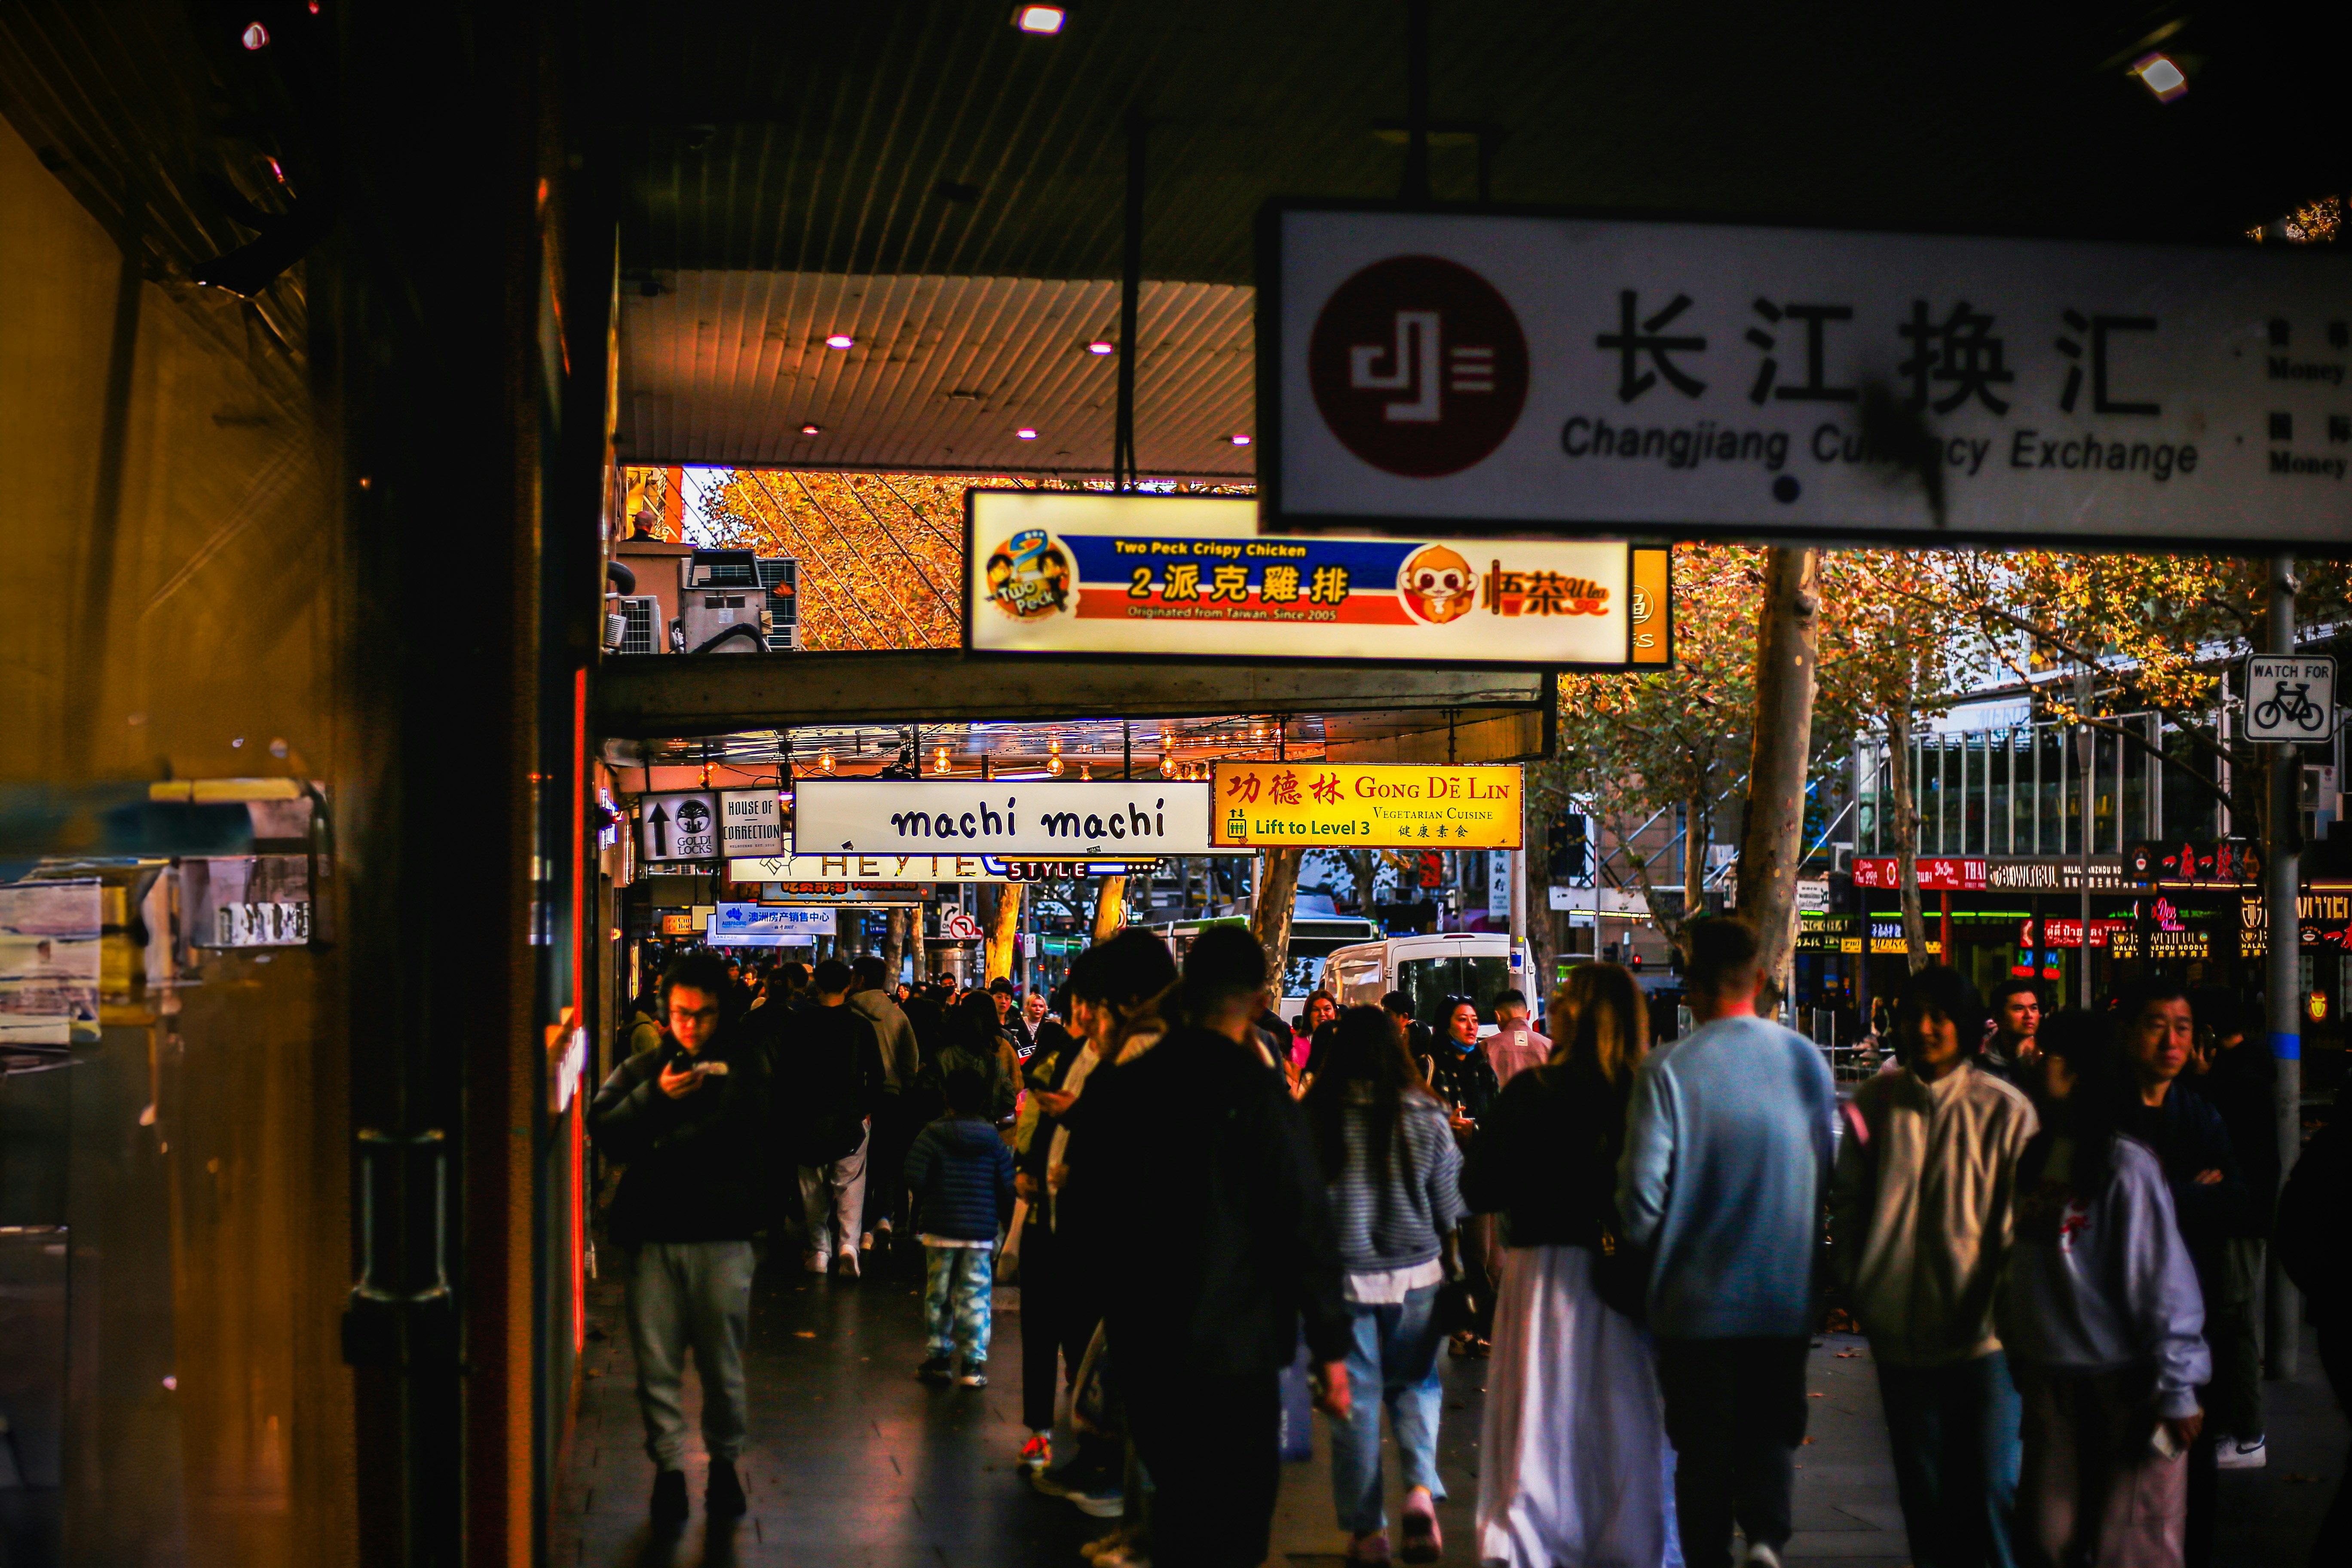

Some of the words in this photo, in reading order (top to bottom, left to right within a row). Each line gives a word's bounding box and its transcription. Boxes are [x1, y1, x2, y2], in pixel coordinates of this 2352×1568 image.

[1596, 290, 2160, 416] 长江换汇
[1560, 416, 1789, 470] Changjiang
[2011, 430, 2198, 481] Exchange
[1115, 541, 1147, 554] Two
[1151, 542, 1188, 555] Peck
[1193, 542, 1241, 558] Crispy
[1246, 543, 1306, 557] Chicken
[1128, 606, 1191, 619] Originated
[1195, 607, 1222, 617] from
[1274, 608, 1304, 619] Since
[1308, 609, 1337, 620] 2005
[2254, 665, 2298, 677] WATCH
[2306, 666, 2329, 678] FOR
[1226, 769, 1344, 805] 功德林
[728, 801, 759, 815] HOUSE
[762, 800, 772, 815] OF
[891, 796, 1016, 839] machi
[1040, 797, 1165, 839] machi
[723, 824, 780, 840] CORRECTION
[1256, 819, 1284, 834] Lift
[1289, 821, 1307, 834] to
[1311, 820, 1355, 835] Level
[1360, 821, 1370, 835] 3
[677, 836, 711, 846] GOLDI
[678, 844, 712, 855] LOCKS
[1011, 862, 1084, 877] STYLE
[1965, 861, 1985, 879] THAI
[2064, 866, 2082, 874] HALAL
[748, 911, 830, 922] 澳洲房产销售中心
